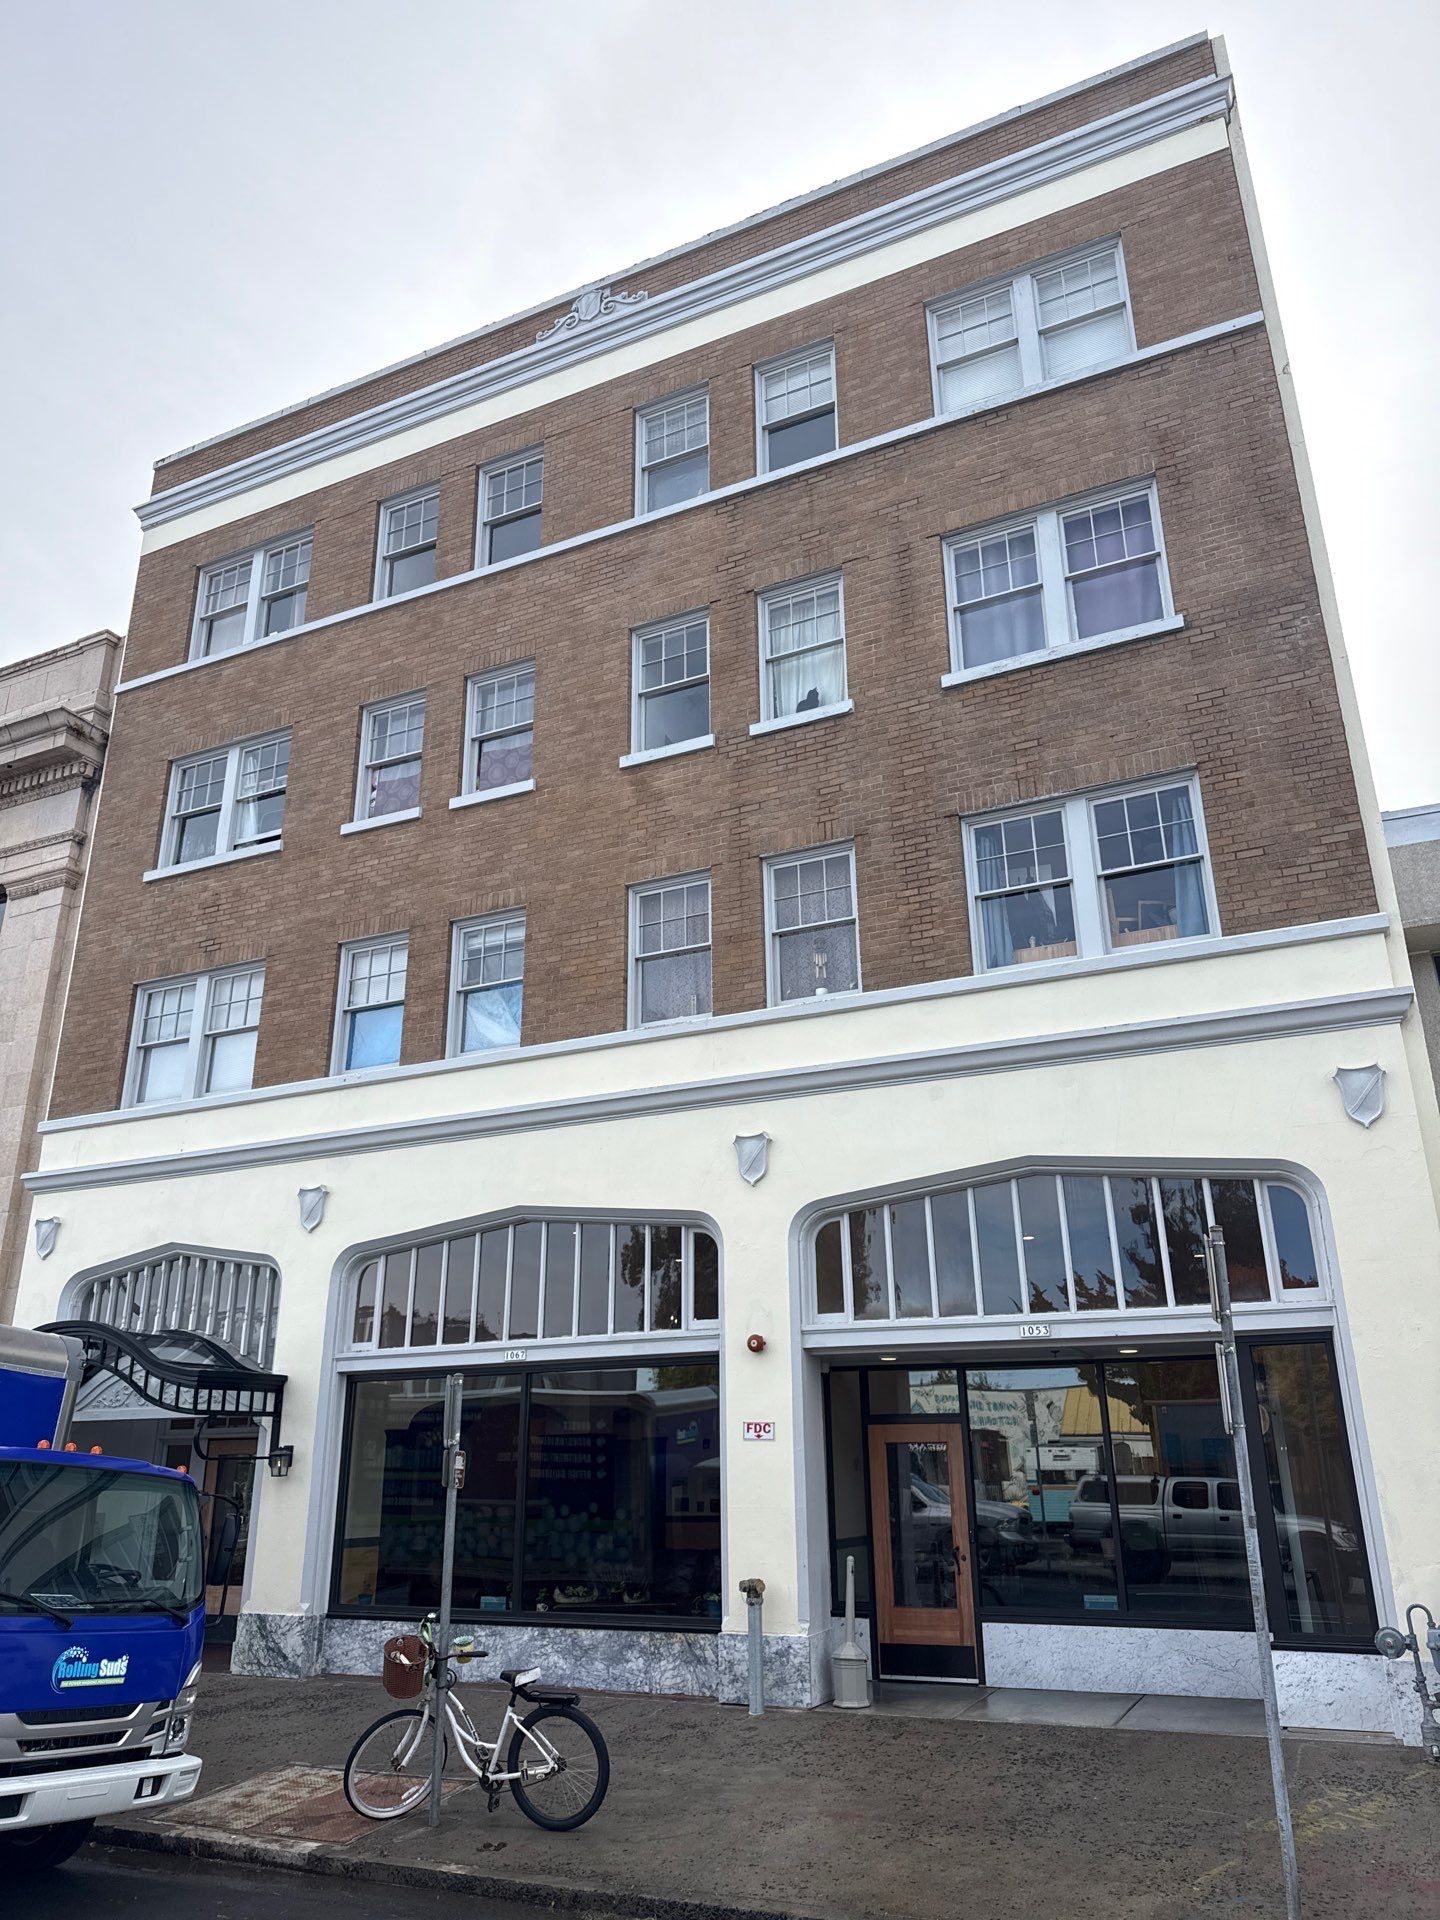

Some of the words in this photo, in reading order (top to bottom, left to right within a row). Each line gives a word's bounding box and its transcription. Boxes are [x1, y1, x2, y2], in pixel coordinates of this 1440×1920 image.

[1022, 1325, 1049, 1336] 1053
[506, 1350, 525, 1360] 1067
[746, 1422, 772, 1434] FDC
[58, 1661, 99, 1678] Rolling
[99, 1658, 128, 1676] Suds
